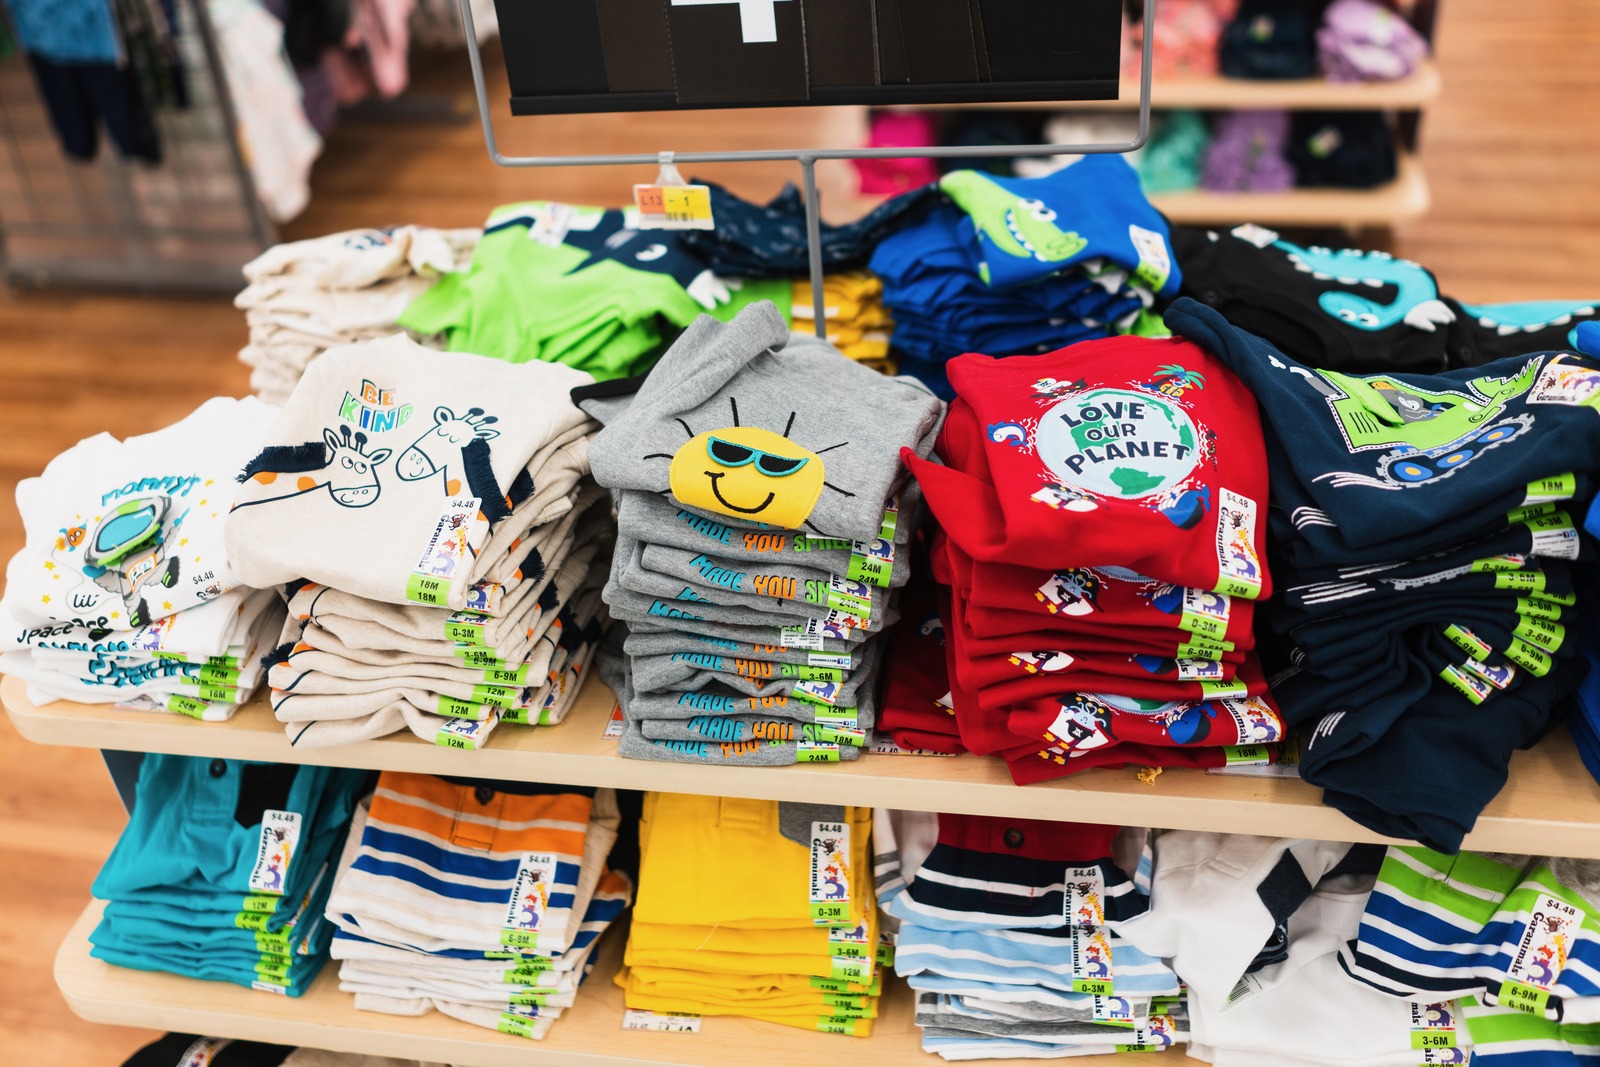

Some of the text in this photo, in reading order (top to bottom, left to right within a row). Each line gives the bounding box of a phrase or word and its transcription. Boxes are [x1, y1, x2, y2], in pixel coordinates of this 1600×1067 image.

[641, 196, 662, 206] L13
[360, 379, 397, 406] BE
[339, 391, 414, 432] KIND
[1060, 401, 1145, 428] LOVE
[1086, 423, 1137, 441] OUR
[1064, 441, 1190, 475] PLANET
[1542, 481, 1563, 492] 18M
[452, 500, 475, 509] $4.48
[1226, 492, 1249, 508] $4.48
[1521, 507, 1544, 520] 18M
[677, 509, 734, 545] MADE
[743, 533, 785, 553] YOU
[1218, 506, 1229, 568] Garanimals
[861, 562, 882, 574] 24M
[192, 570, 215, 585] $4.48
[689, 553, 746, 592] MADE
[753, 575, 797, 600] YOU
[858, 574, 879, 585] 24M
[1508, 572, 1536, 582] 3-6M
[419, 580, 439, 590] 18M
[1226, 583, 1248, 596] 24M
[418, 592, 436, 602] 18M
[839, 598, 860, 610] 24M
[1528, 599, 1552, 612] 3-6M
[1192, 618, 1217, 633] 0-3M
[1531, 617, 1556, 633] 3-6M
[452, 628, 475, 638] 0-3M
[1525, 630, 1552, 645] 3-6M
[1187, 648, 1213, 659] 6-9M
[1521, 644, 1544, 663] 6-9M
[473, 657, 497, 667] 6-9M
[735, 658, 773, 678] YOU
[210, 668, 229, 679] 12M
[494, 670, 517, 681] 6-9M
[809, 672, 833, 681] 3-6M
[209, 689, 226, 699] 18M
[487, 687, 506, 697] 12M
[678, 691, 736, 713] MADE
[450, 705, 469, 715] 12M
[827, 705, 847, 714] 12M
[1223, 699, 1248, 744] aranimals
[688, 715, 746, 742] MADE
[447, 738, 465, 749] 12M
[834, 735, 853, 745] 18M
[1236, 749, 1257, 758] 18M
[819, 823, 843, 833] $4.48
[812, 838, 822, 897] Garanimals
[1073, 868, 1096, 877] $4.48
[507, 868, 529, 924] Garanimals
[818, 907, 841, 917] 0-3M
[1546, 899, 1576, 916] $4.48
[1511, 911, 1544, 976] Garanimals
[837, 947, 859, 956] 3-6M
[843, 968, 861, 977] 12M
[1082, 984, 1105, 993] 0-3M
[1511, 986, 1538, 1002] 6-9M
[1508, 1000, 1535, 1014] 6-9M
[1422, 1036, 1448, 1045] 3-6M
